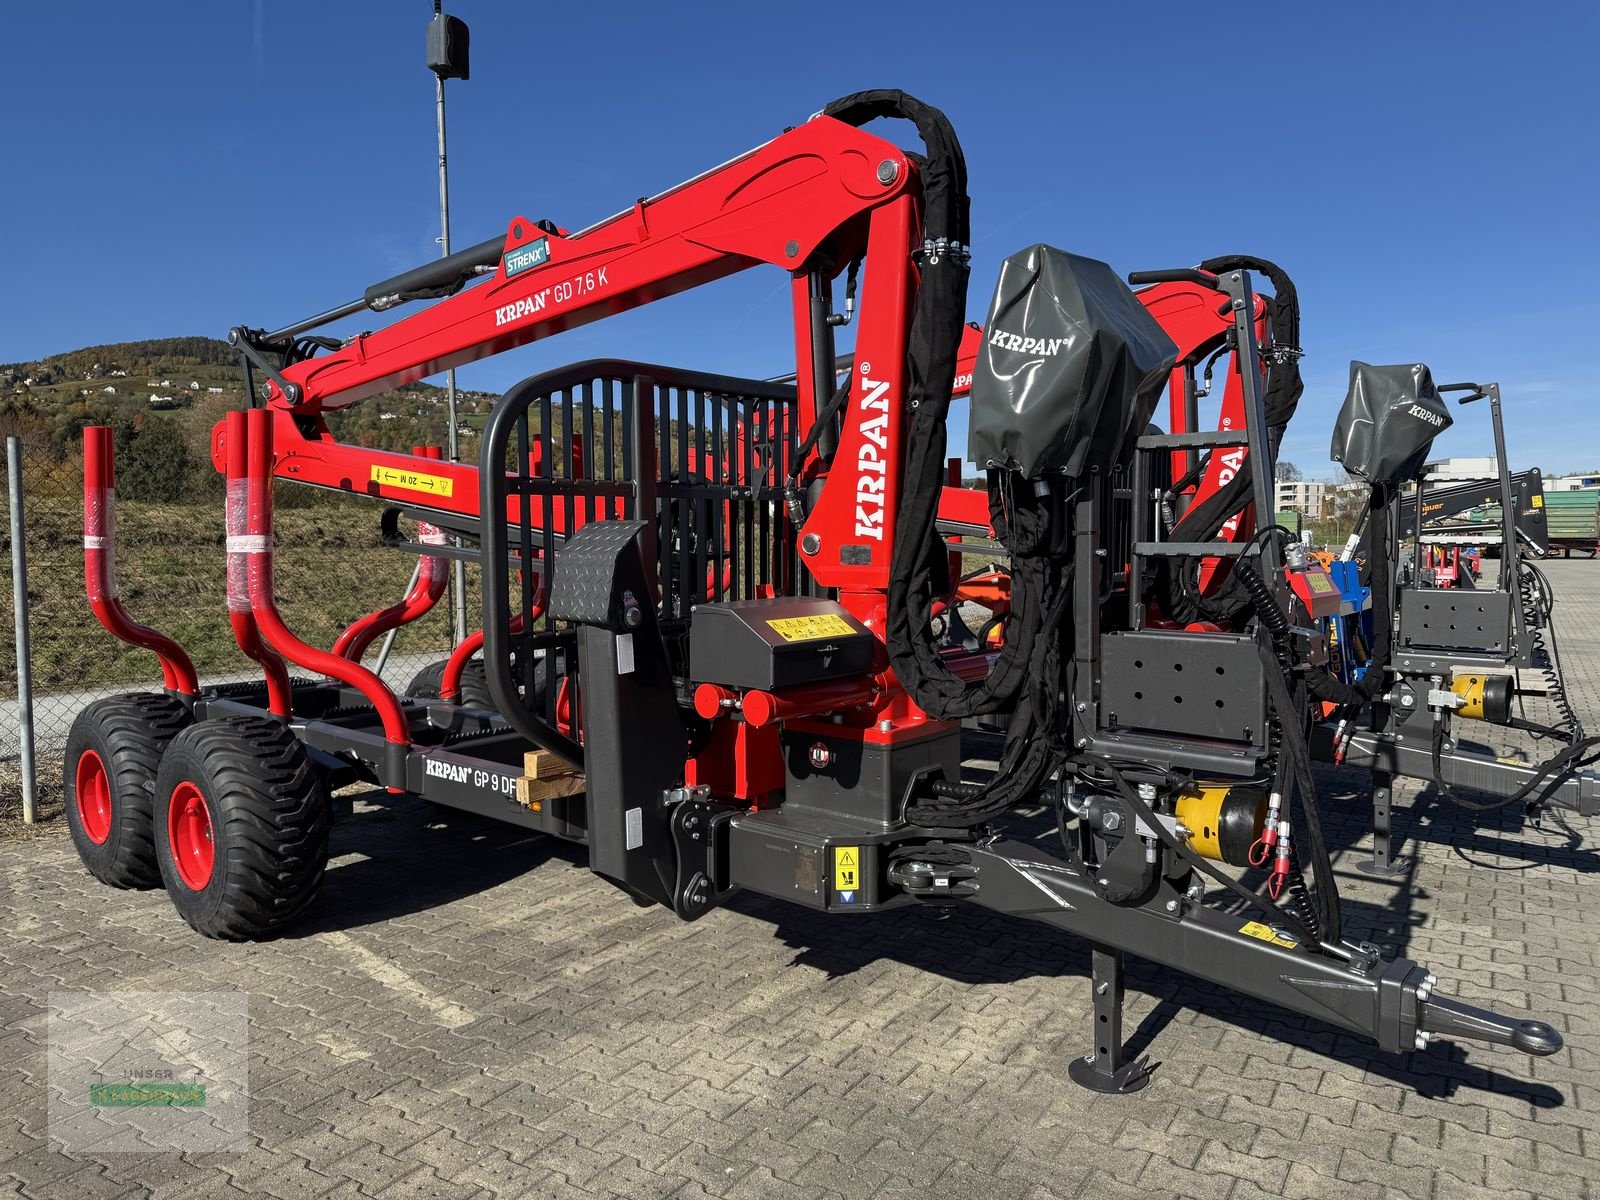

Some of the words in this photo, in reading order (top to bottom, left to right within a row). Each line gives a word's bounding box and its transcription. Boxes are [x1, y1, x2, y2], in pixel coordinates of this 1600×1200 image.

[507, 247, 542, 273] STRENX
[553, 281, 573, 303] GD
[574, 272, 595, 296] 7,6
[597, 266, 609, 287] K
[1408, 404, 1443, 427] KRPAN
[400, 474, 407, 484] M
[408, 476, 417, 486] 20
[474, 770, 489, 787] GP
[491, 774, 499, 791] 9
[501, 776, 516, 794] DF
